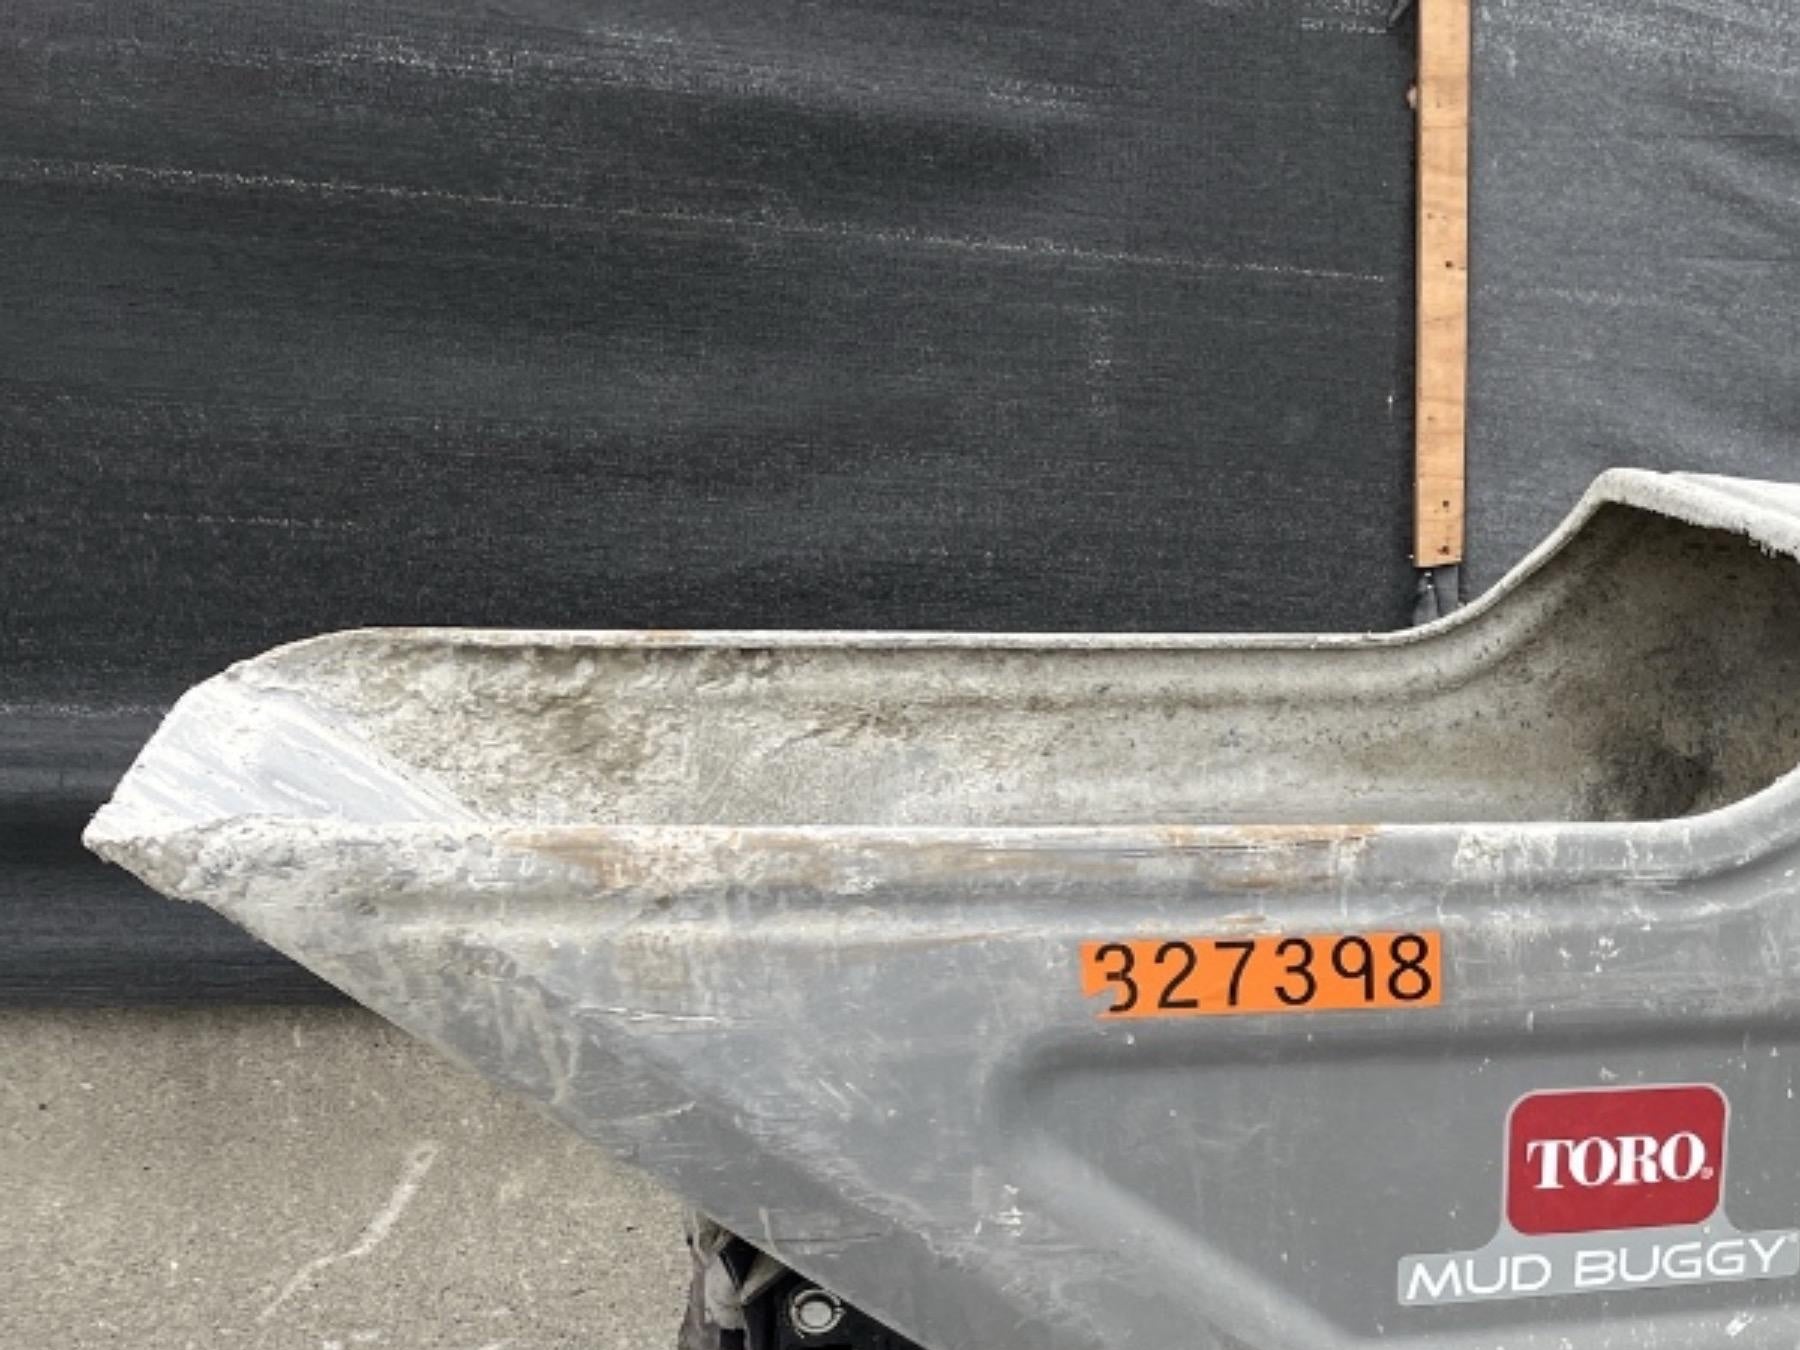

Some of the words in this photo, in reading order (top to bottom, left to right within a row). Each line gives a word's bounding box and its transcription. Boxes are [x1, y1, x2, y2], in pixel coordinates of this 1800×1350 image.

[1095, 933, 1431, 1012] 327398
[1406, 1253, 1552, 1301] MUD
[1574, 1235, 1785, 1288] BUGGY
